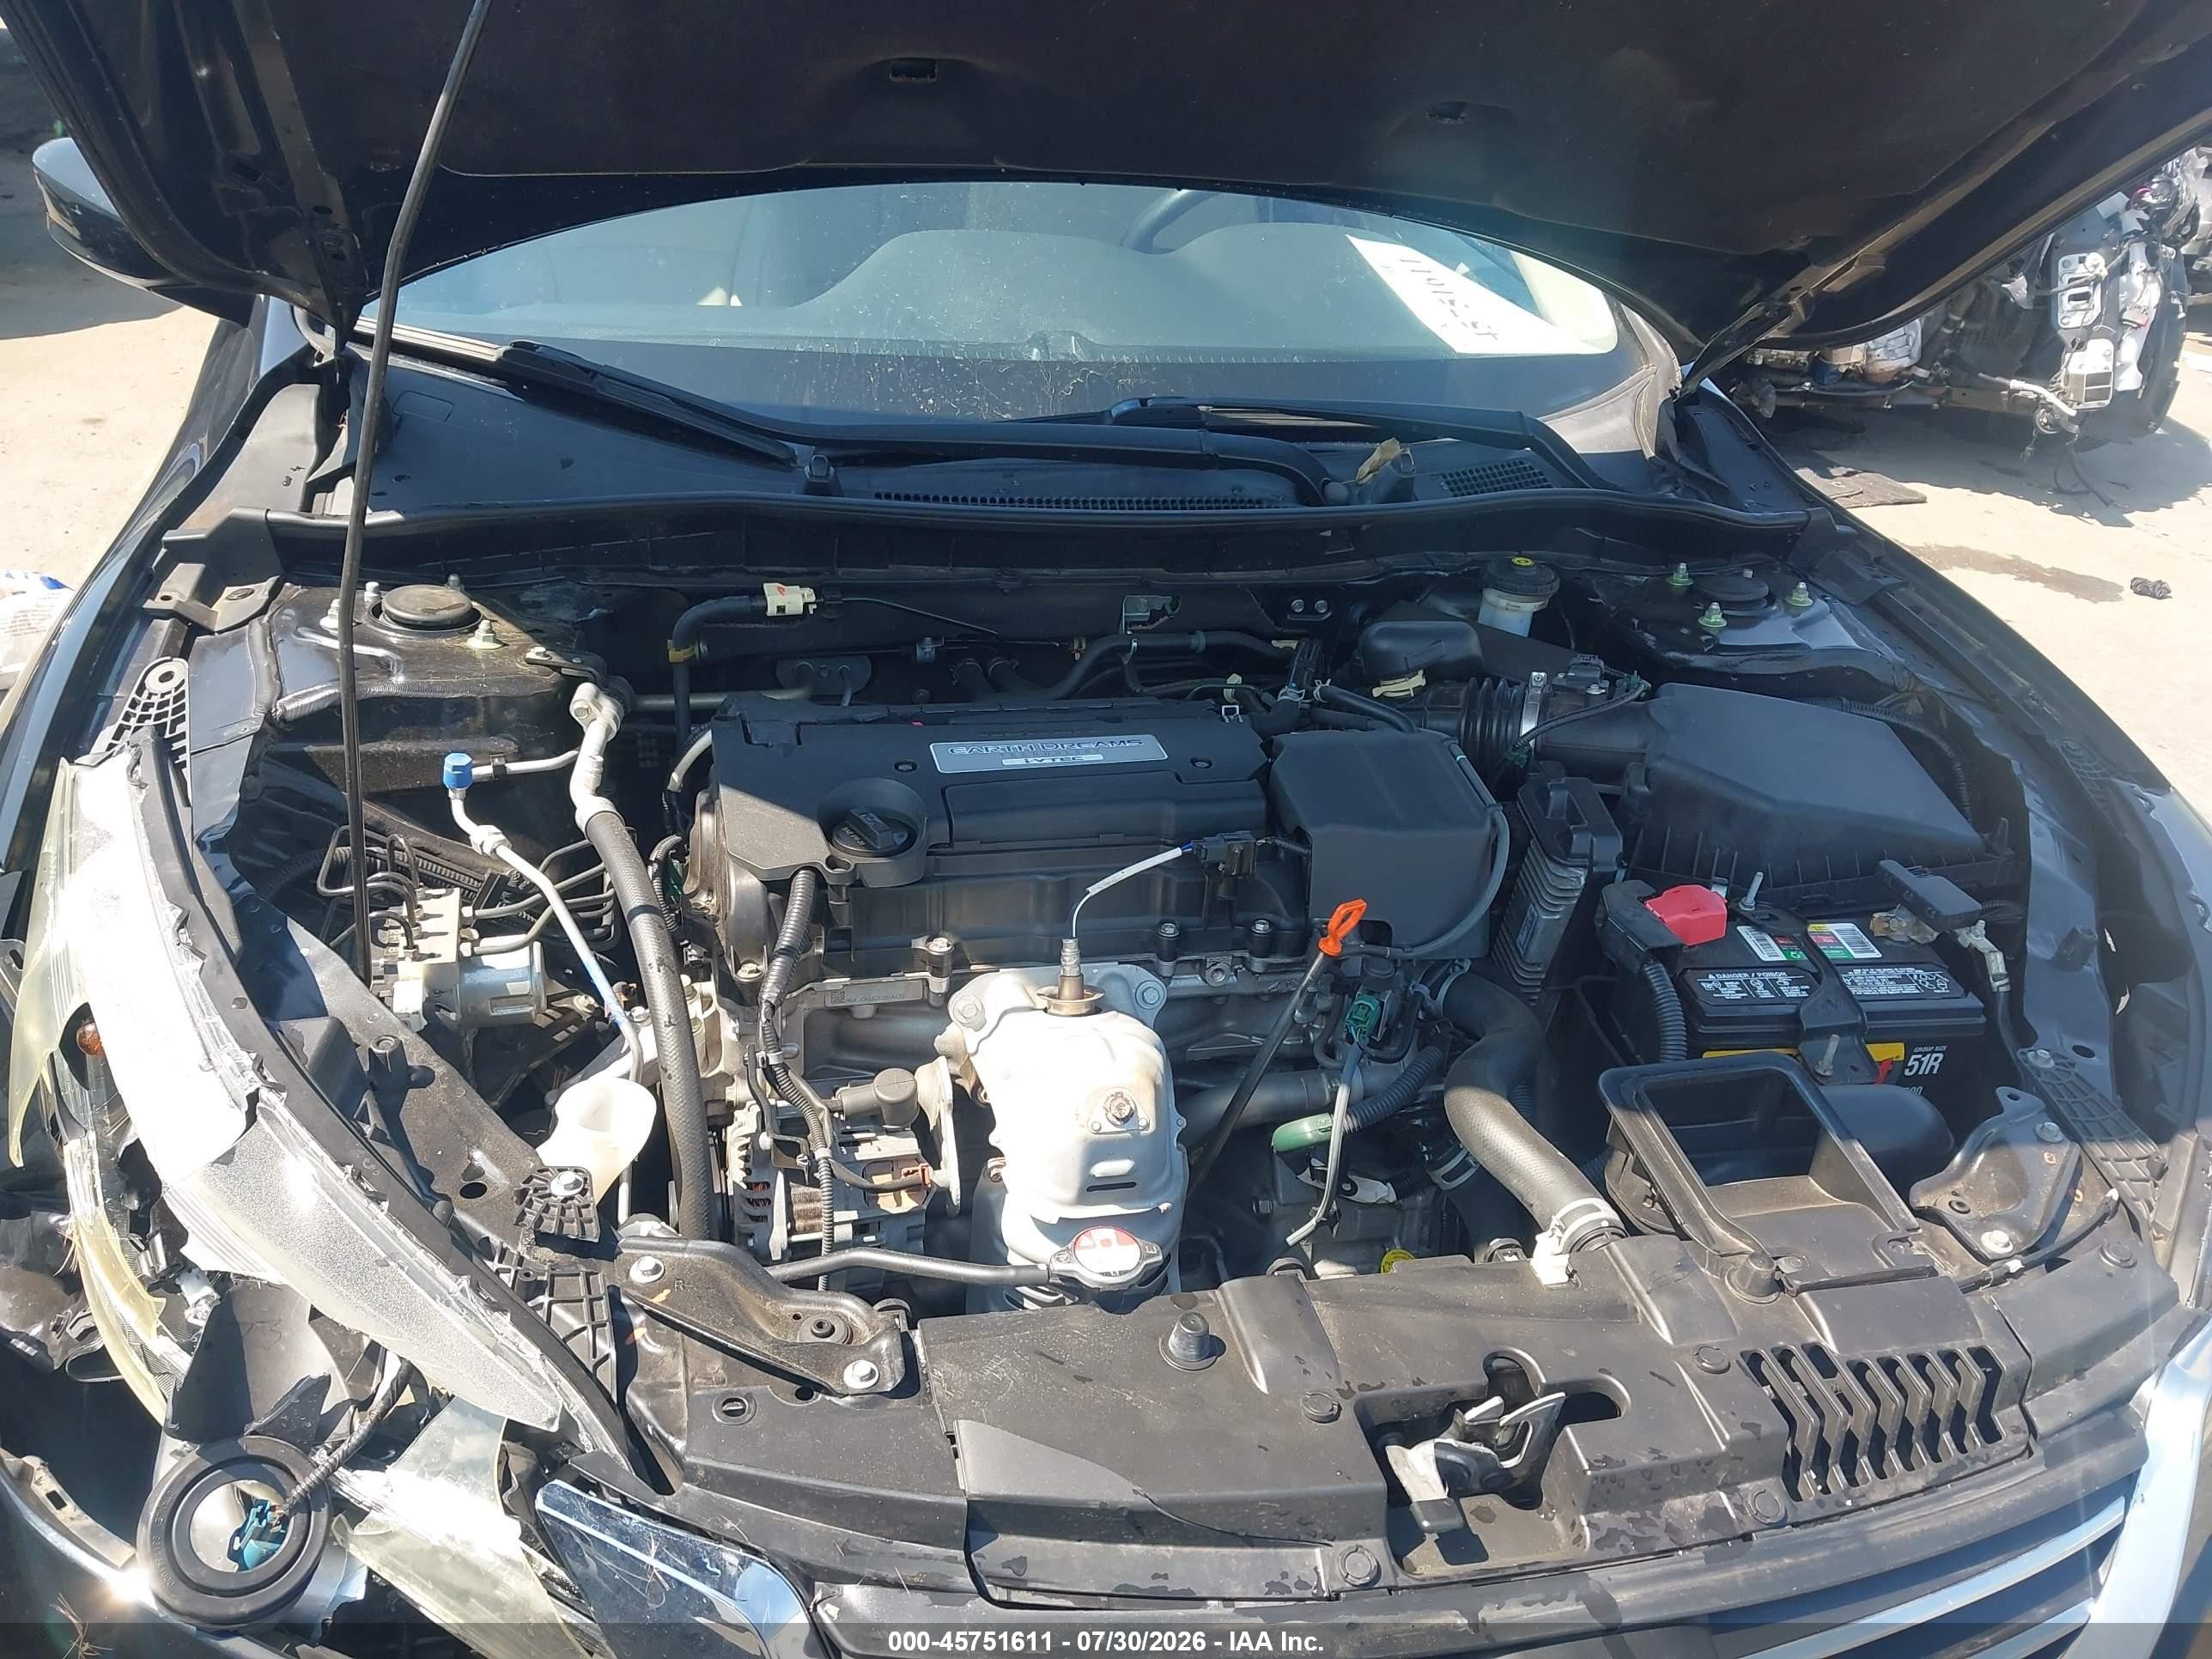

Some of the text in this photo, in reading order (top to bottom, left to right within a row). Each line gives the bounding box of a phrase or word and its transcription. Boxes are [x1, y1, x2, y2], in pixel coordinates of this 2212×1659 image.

[948, 738, 1144, 755] EARTH DREAMS
[1904, 1053, 1944, 1077] 51R
